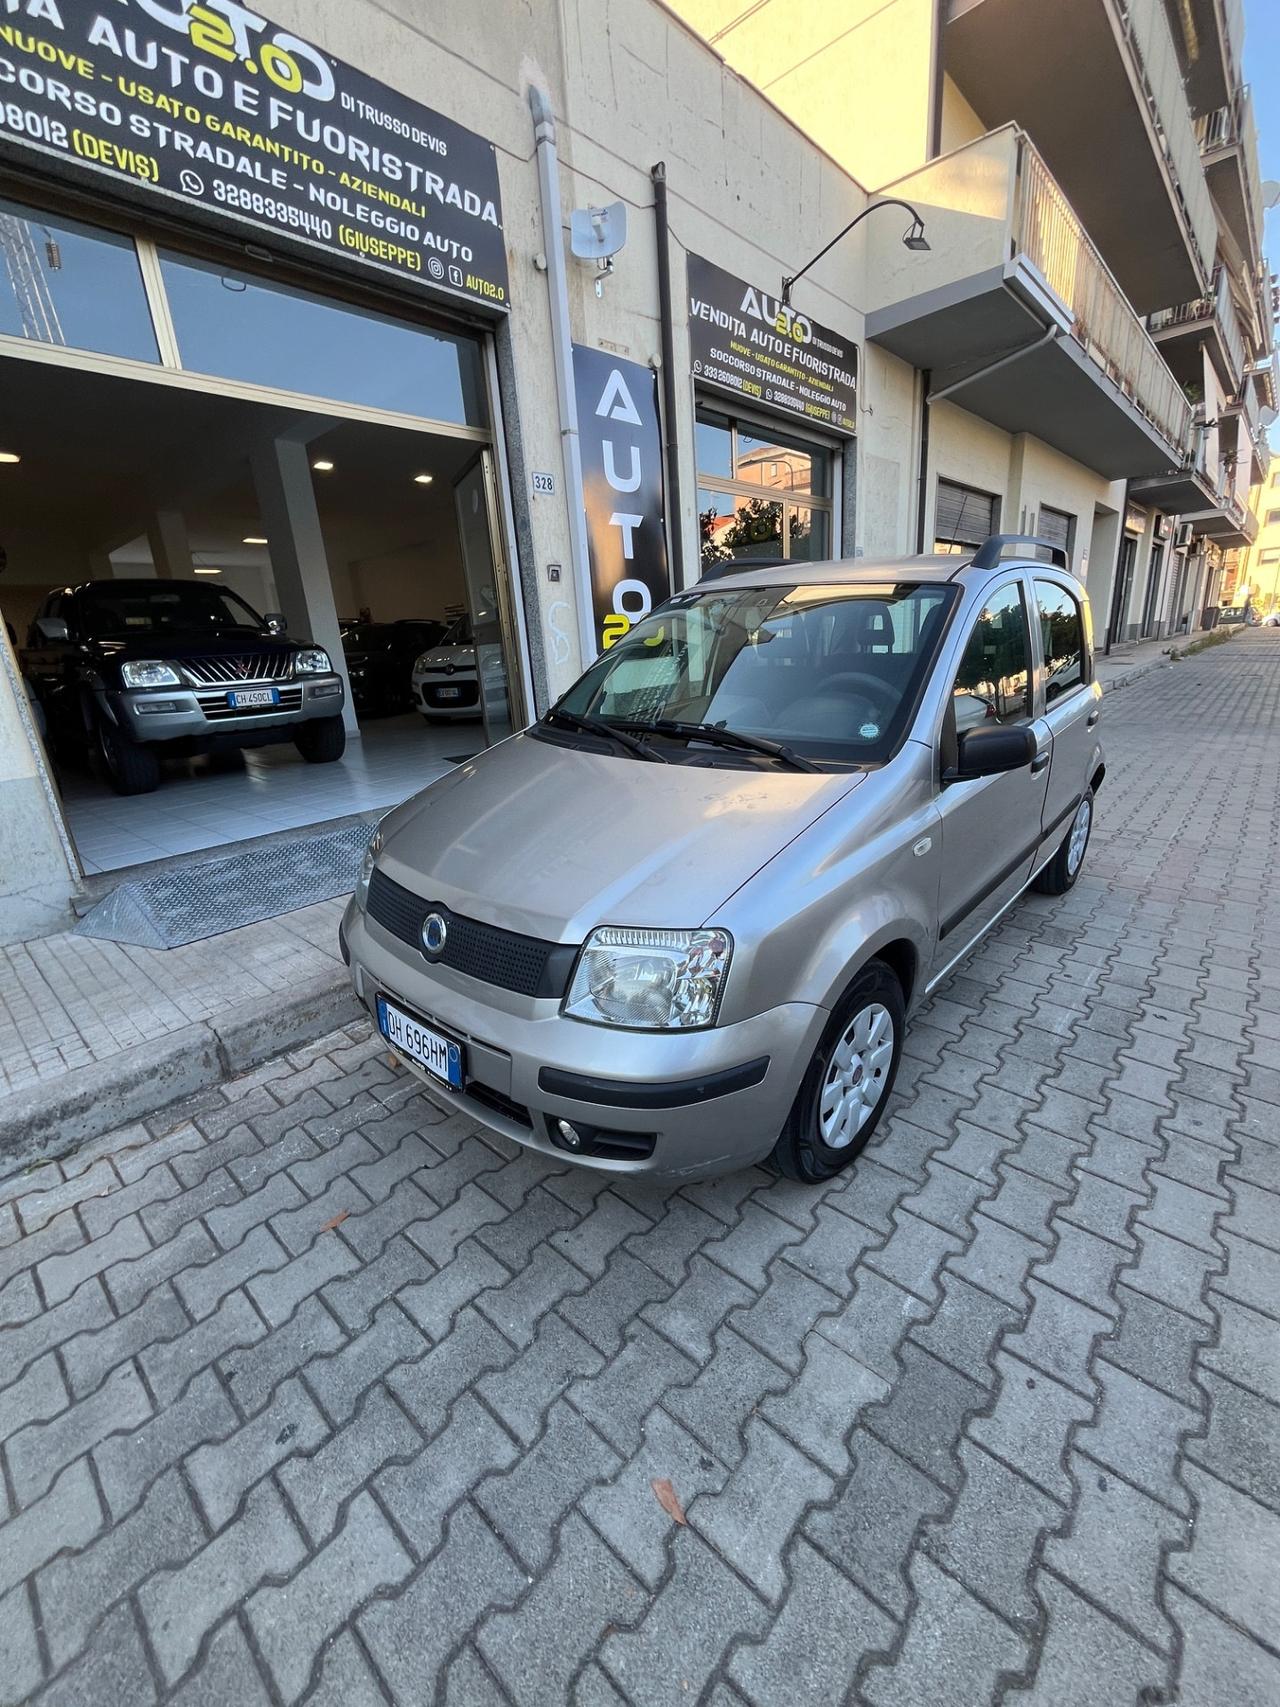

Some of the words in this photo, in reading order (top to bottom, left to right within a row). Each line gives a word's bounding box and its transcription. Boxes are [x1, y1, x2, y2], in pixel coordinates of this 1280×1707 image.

[117, 0, 335, 101] UTO
[0, 24, 95, 80] NUOVE
[118, 77, 201, 124] USATO
[205, 114, 325, 175] GARANTITO
[339, 171, 426, 218] AZIENDALI
[88, 15, 223, 99] AUTO
[234, 80, 260, 116] E
[270, 96, 499, 227] FUORISTRADA
[341, 92, 355, 112] DI
[356, 100, 409, 139] TRUSSO
[411, 127, 448, 156] DEVIS
[72, 128, 160, 183] (DEVIS)
[213, 179, 332, 241] 3288335440
[338, 223, 421, 272] (GIUSEPPE)
[466, 274, 505, 301] AUTO2.0
[129, 113, 288, 190] STRADALE
[308, 182, 420, 241] NOLEGGIO
[423, 231, 473, 263] AUTO
[691, 297, 747, 339] VENDITA
[750, 328, 783, 354] AUTO
[784, 344, 792, 358] E
[792, 347, 856, 389] FUORISTRADA
[740, 287, 812, 343] AUTO
[710, 347, 756, 375] SOCCORSO
[756, 368, 795, 391] STRADALE
[799, 385, 831, 405] NOLEGGIO
[831, 399, 847, 412] AUTO
[535, 475, 553, 491] 328
[595, 369, 652, 624] AUTO
[388, 1011, 403, 1042] DH
[406, 1023, 447, 1072] 696HM
